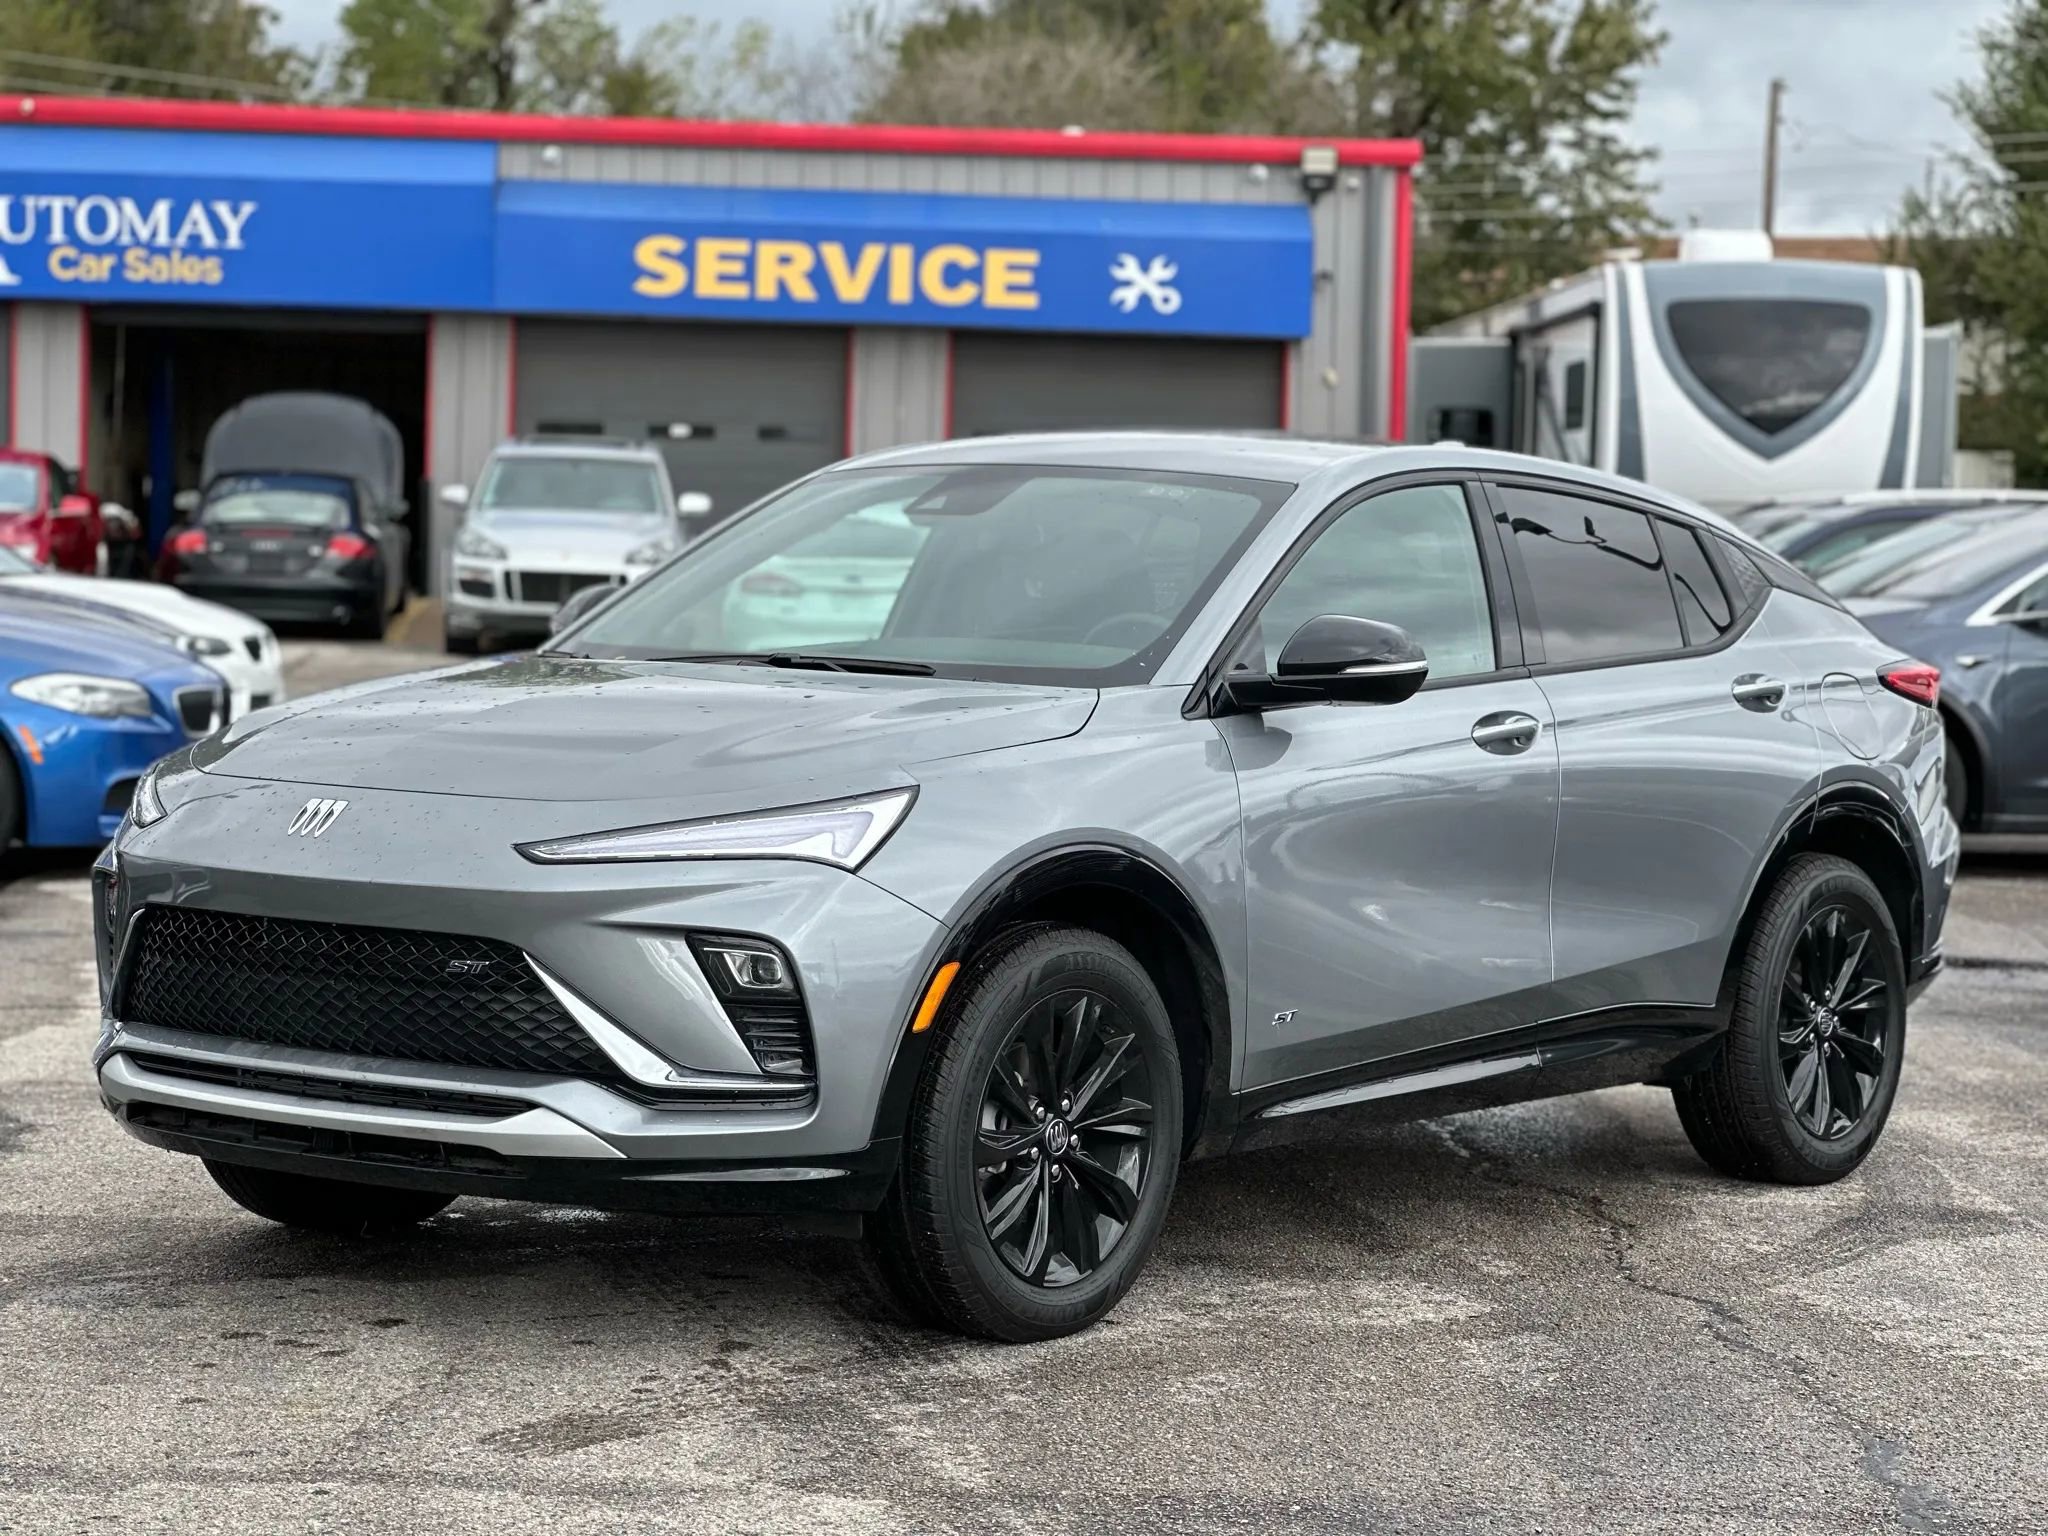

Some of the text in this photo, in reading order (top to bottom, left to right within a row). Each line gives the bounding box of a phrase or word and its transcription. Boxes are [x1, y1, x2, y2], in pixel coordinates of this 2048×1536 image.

[0, 193, 258, 250] UTOMAY
[48, 246, 223, 285] Car Sales
[632, 235, 1041, 309] SERVICE
[446, 959, 490, 974] ST
[1271, 1009, 1299, 1026] ST
